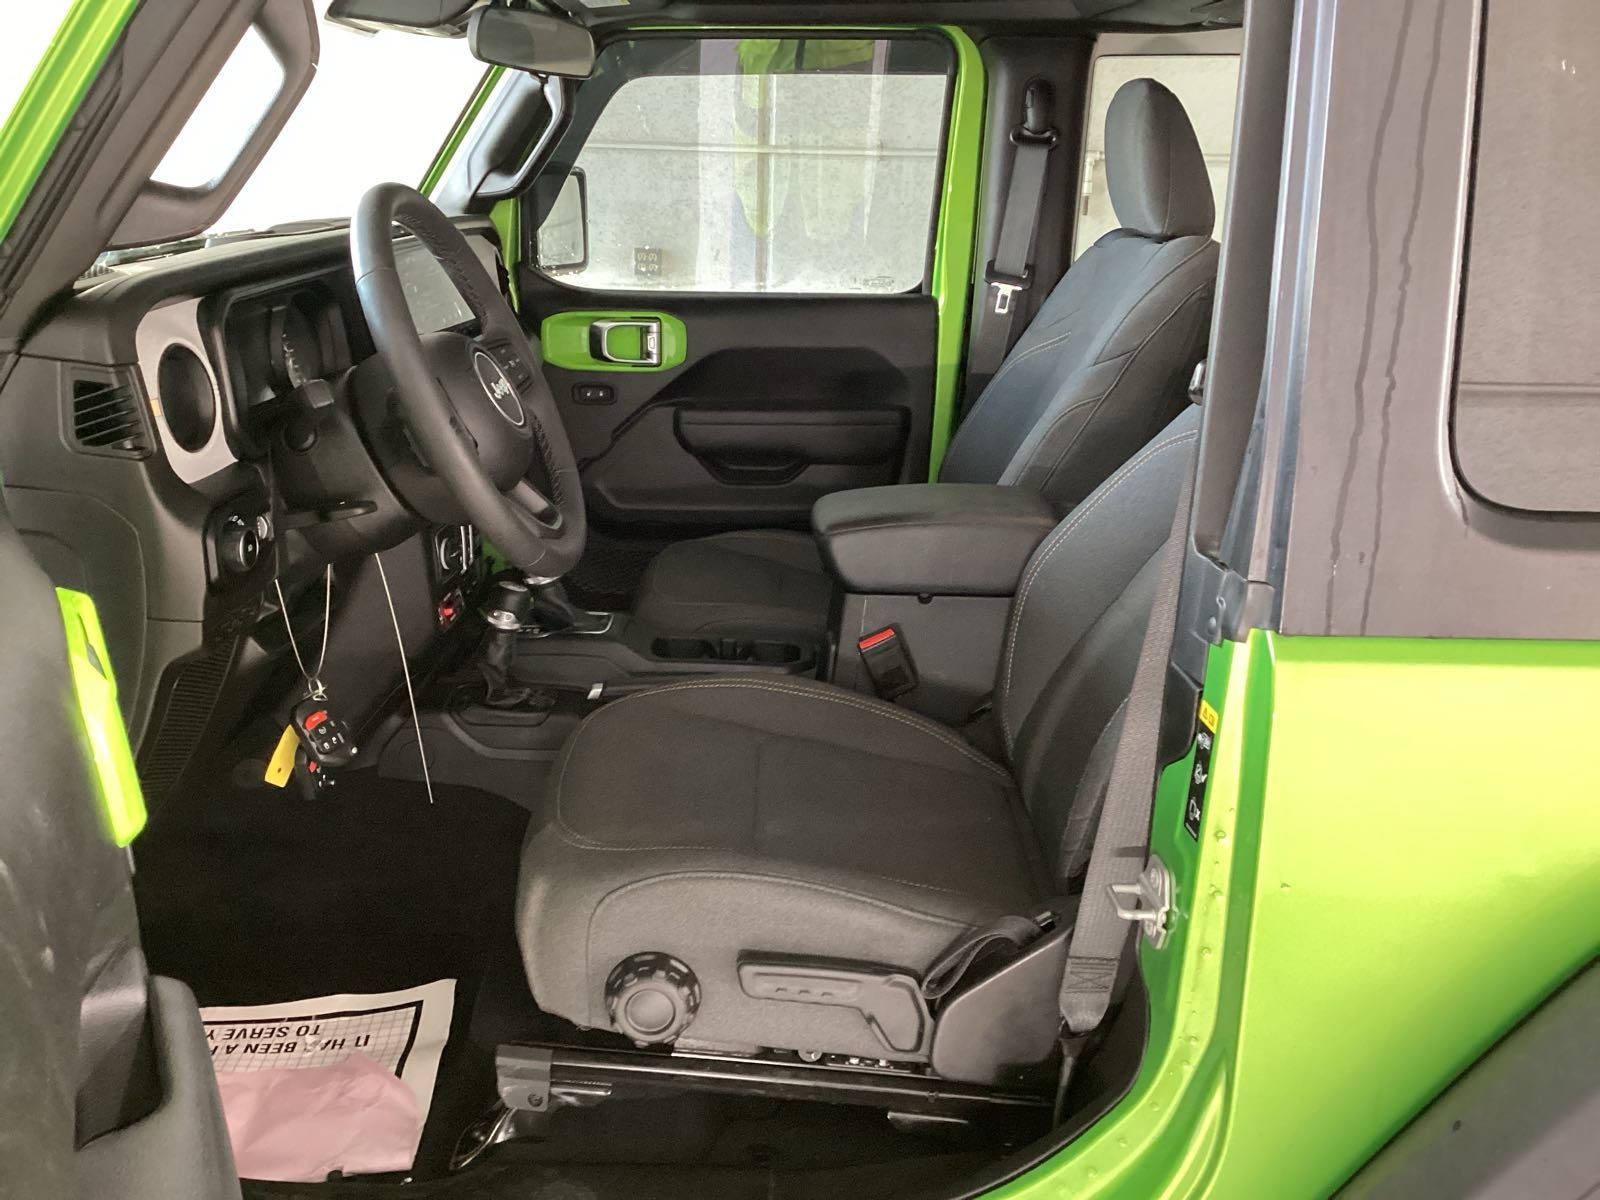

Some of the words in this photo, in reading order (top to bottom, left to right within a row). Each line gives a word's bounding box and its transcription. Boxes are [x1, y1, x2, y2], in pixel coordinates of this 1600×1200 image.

[222, 1026, 290, 1040] SERVE
[296, 1024, 321, 1037] TO
[225, 1044, 239, 1056] A
[243, 1041, 298, 1055] BEEN
